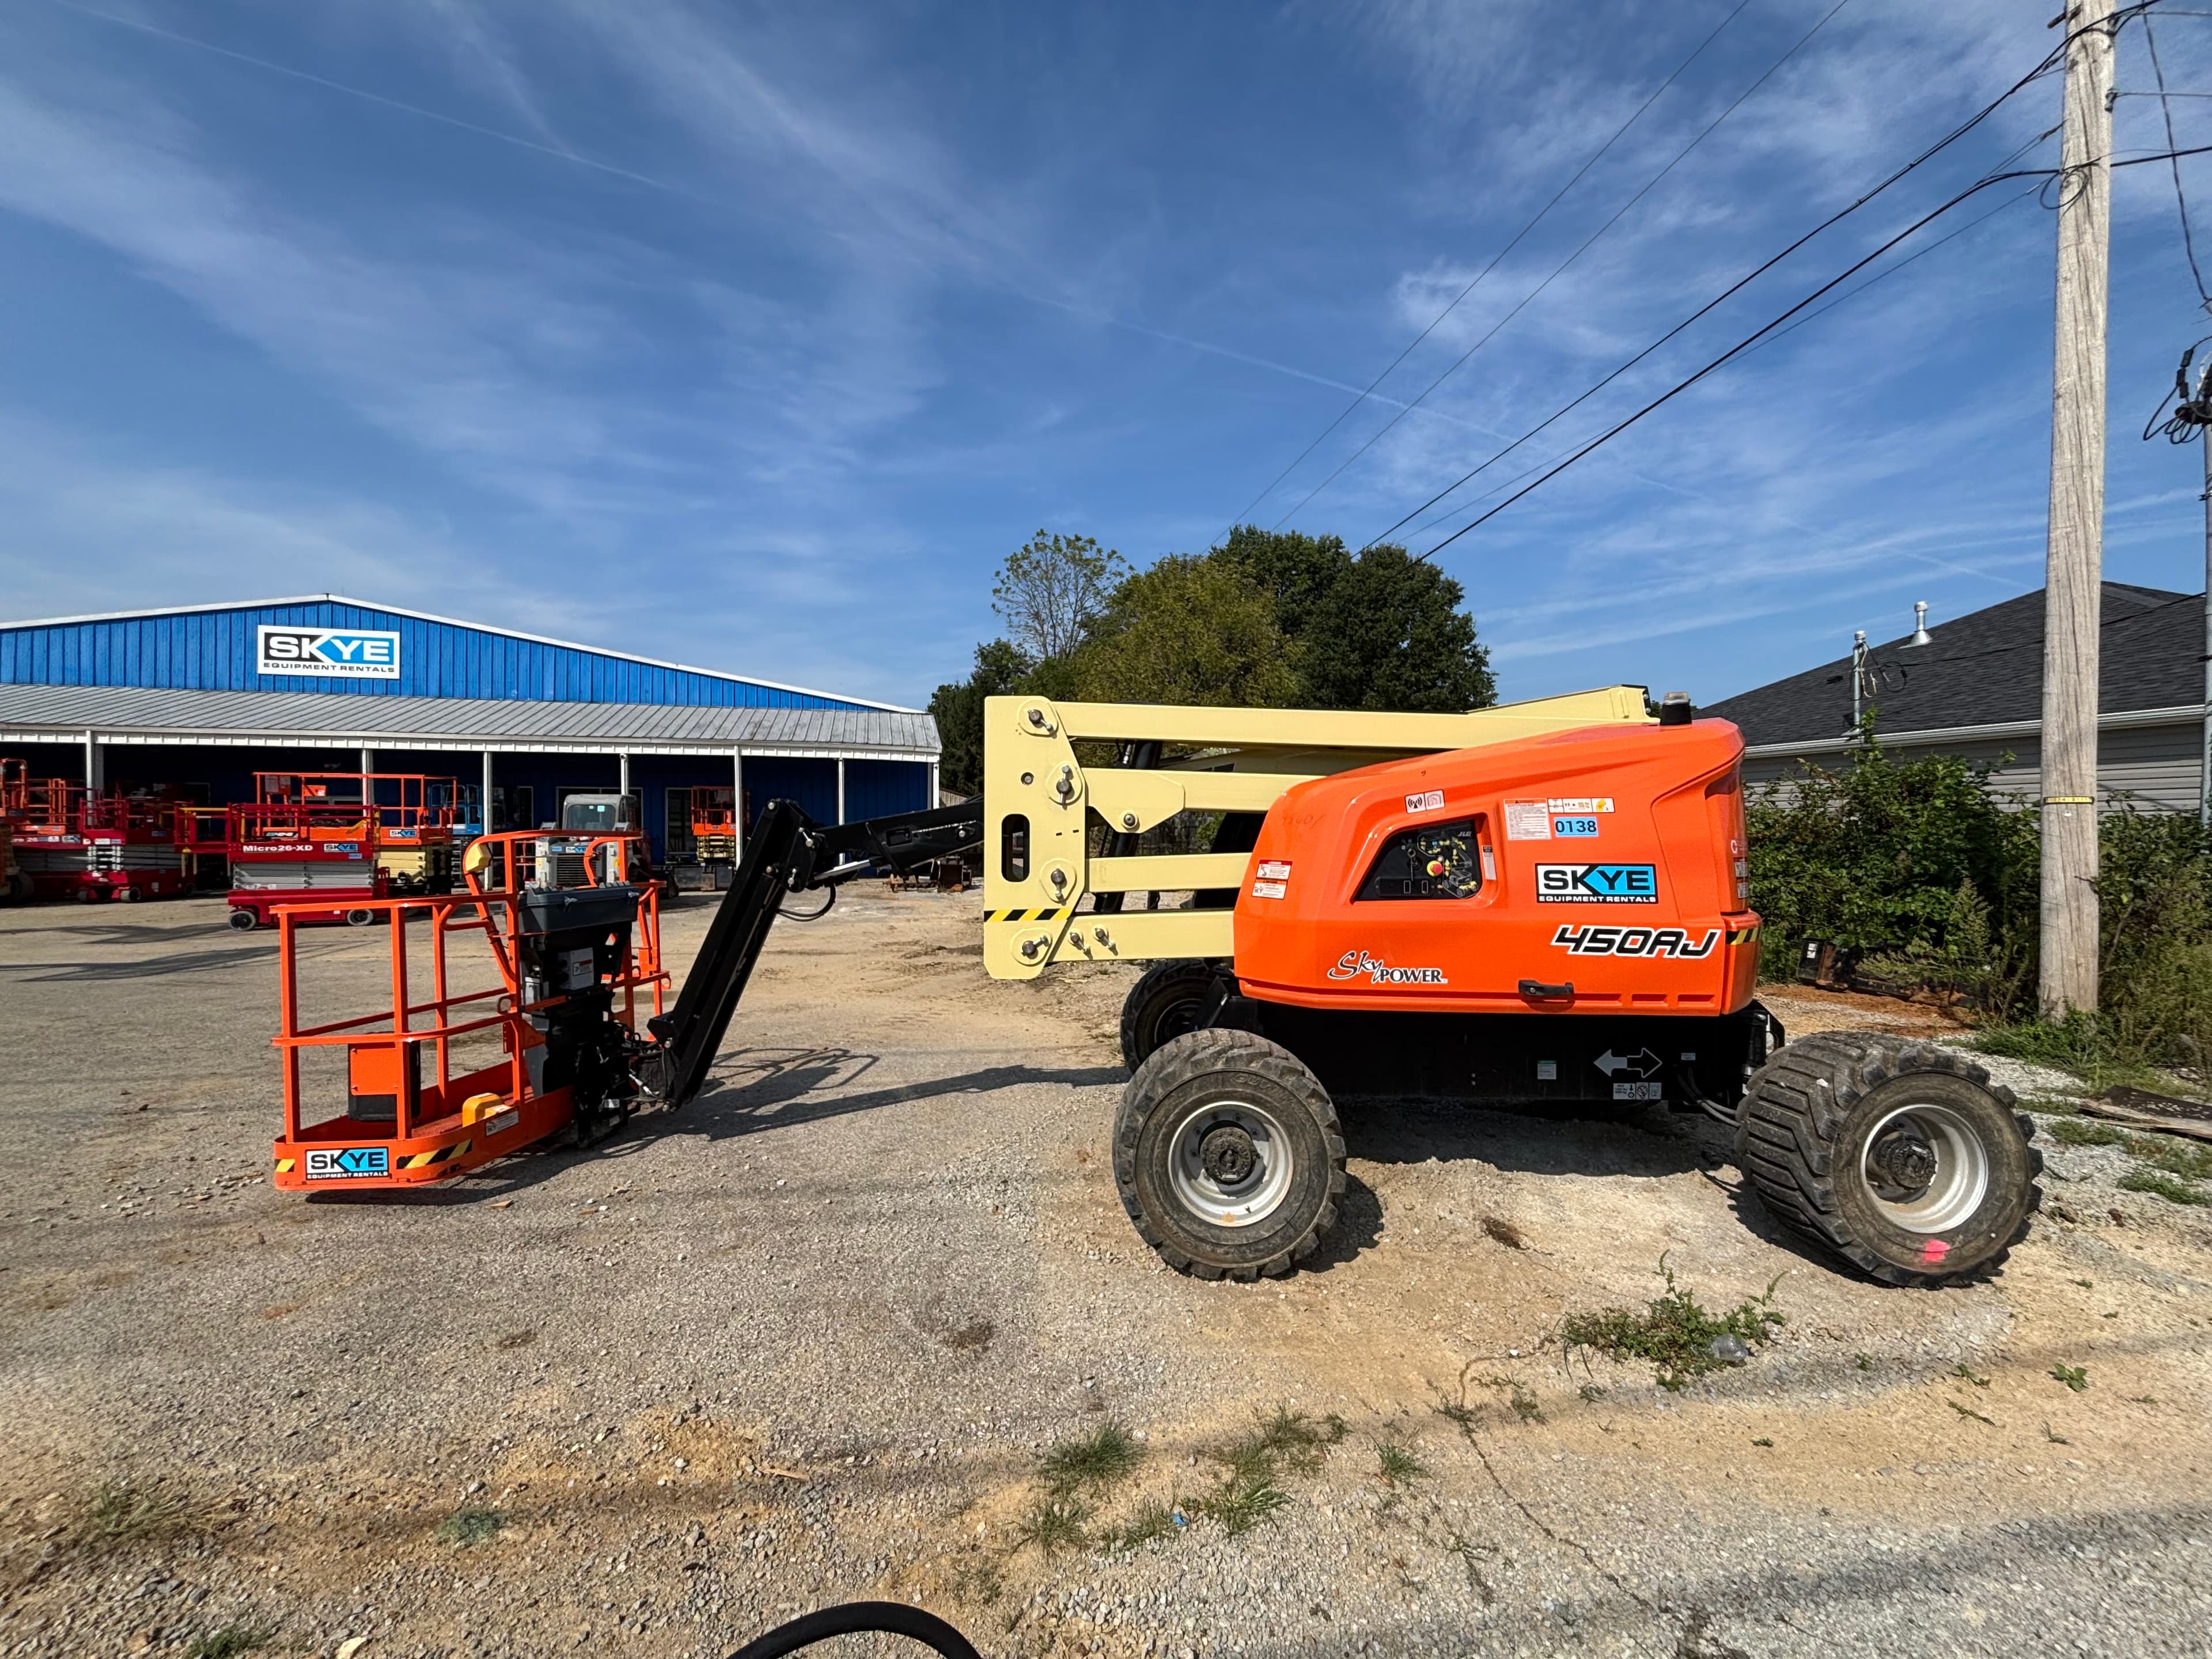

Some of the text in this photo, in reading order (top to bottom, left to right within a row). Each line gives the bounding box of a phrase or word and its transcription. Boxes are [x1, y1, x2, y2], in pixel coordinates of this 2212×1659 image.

[269, 636, 390, 662] SKYE
[263, 662, 395, 673] EQUIPMENT RENTALS
[1555, 820, 1597, 833] 0138
[1543, 869, 1651, 892] SKYE
[1552, 926, 1722, 957] 450AJ
[310, 1152, 385, 1169] SKYE
